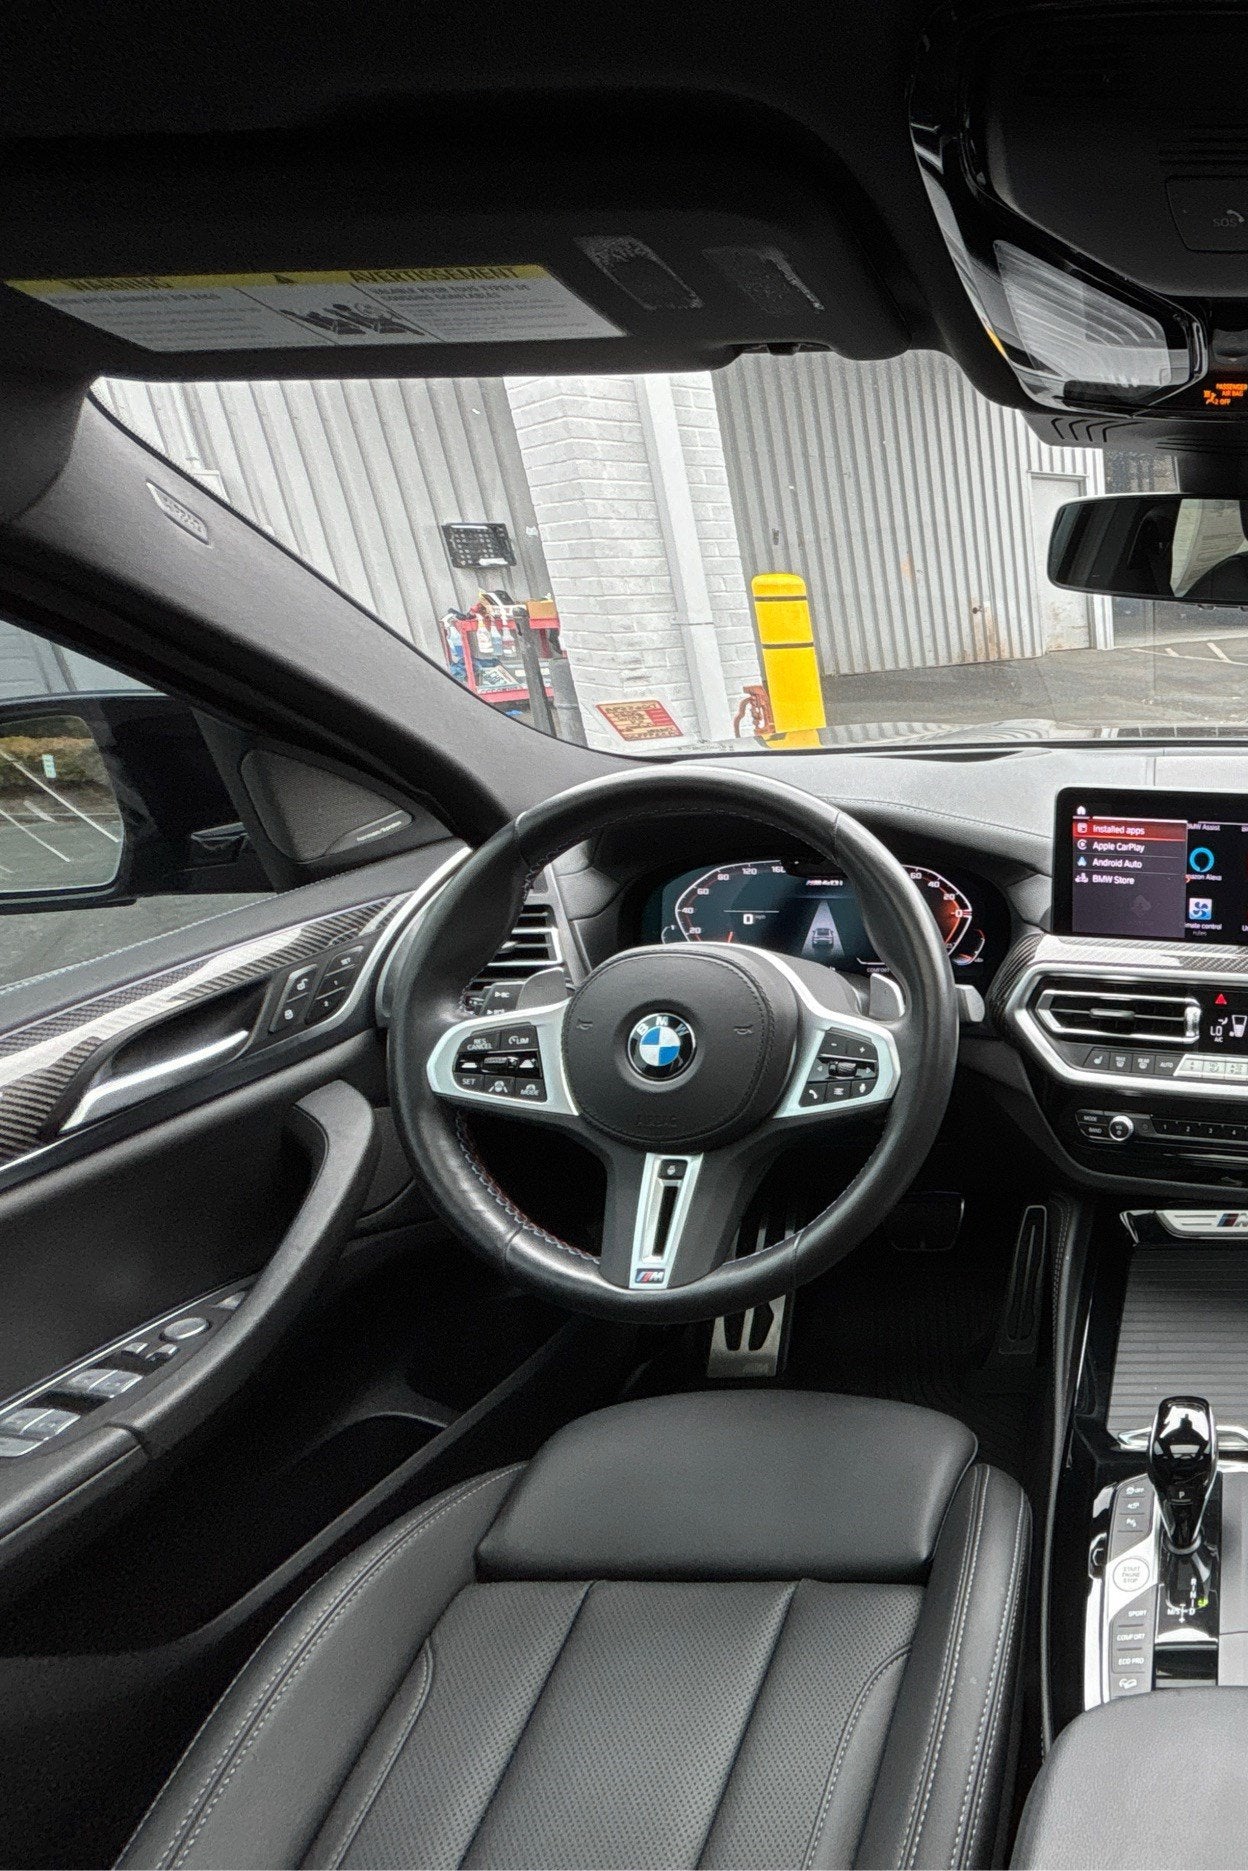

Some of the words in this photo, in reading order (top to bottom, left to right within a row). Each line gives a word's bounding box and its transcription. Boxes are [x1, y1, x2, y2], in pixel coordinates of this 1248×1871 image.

[1213, 218, 1237, 227] SOS
[351, 267, 520, 282] AVERTISSEMENT
[1092, 825, 1124, 834] Installed
[1125, 827, 1145, 835] apps
[1092, 842, 1115, 851] Apple
[1116, 843, 1145, 853] CarPlay
[1092, 858, 1122, 867] Android
[1123, 859, 1142, 868] Auto
[1092, 875, 1113, 883] BMW
[1114, 875, 1135, 885] Store
[743, 914, 754, 925] 0
[636, 1016, 690, 1037] BMW
[1210, 1026, 1222, 1036] LO
[1128, 1609, 1147, 1617] SPORT
[1117, 1633, 1145, 1641] COMFORT
[1118, 1657, 1131, 1665] ECO
[1131, 1657, 1144, 1665] PRO
